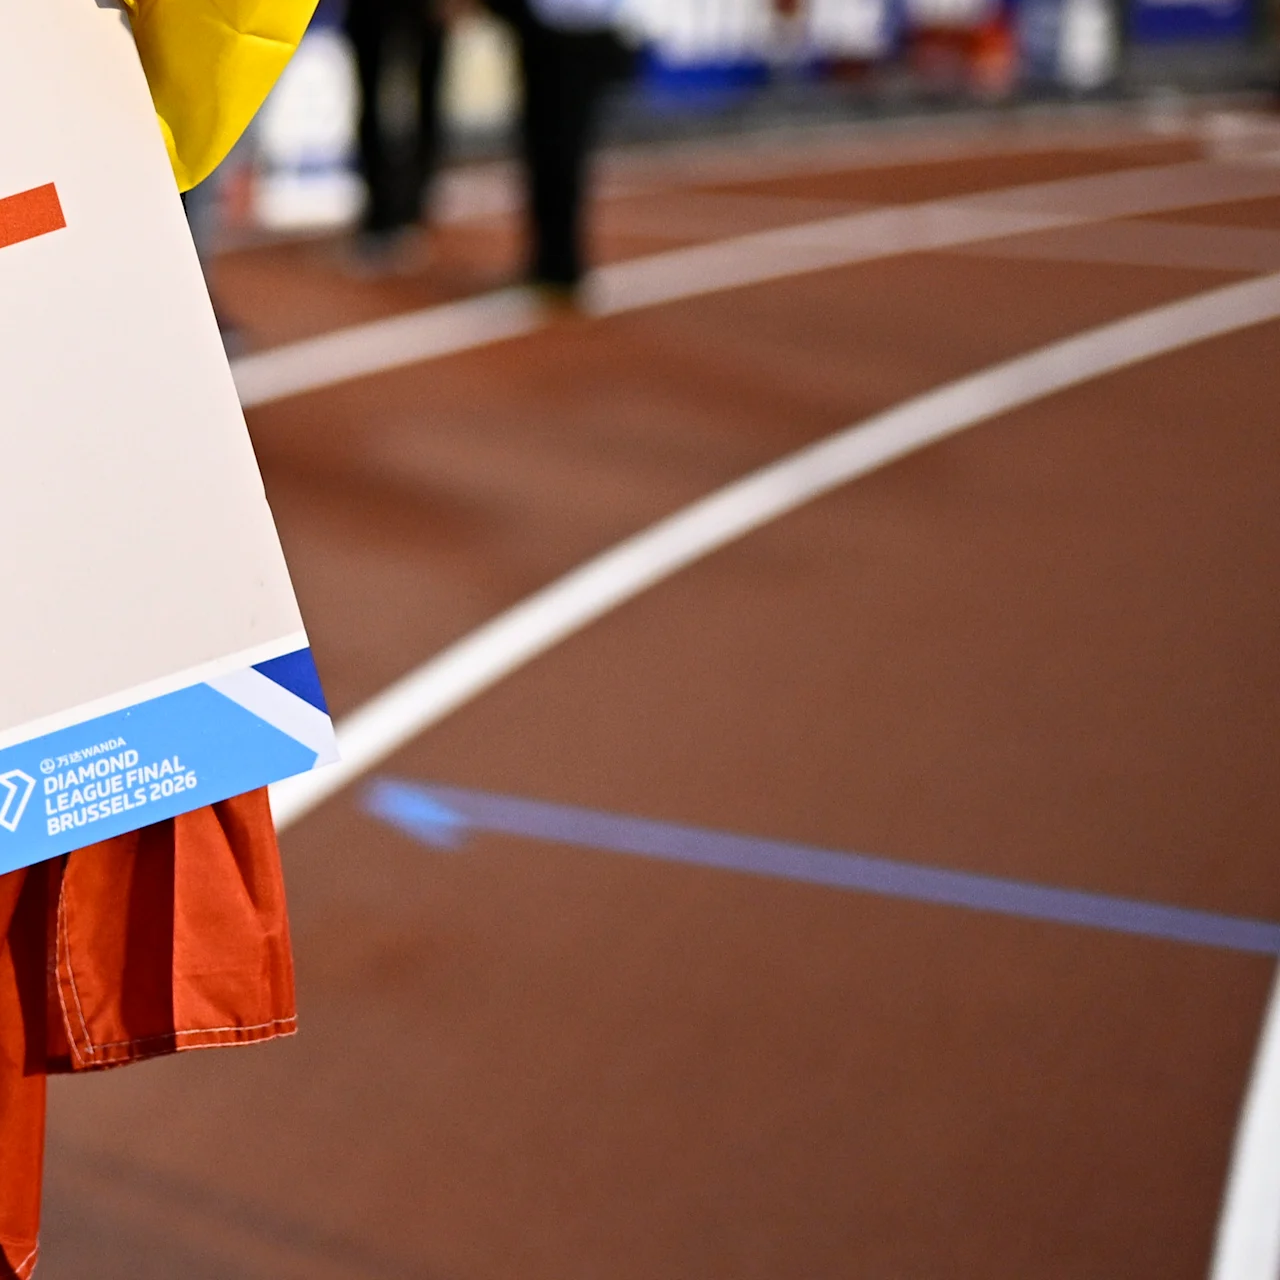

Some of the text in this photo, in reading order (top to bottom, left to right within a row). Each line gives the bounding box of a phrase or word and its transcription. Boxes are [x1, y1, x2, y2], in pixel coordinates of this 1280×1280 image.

[43, 749, 139, 795] DIAMOND
[45, 754, 186, 816] LEAGUE FINAL
[46, 770, 198, 836] BRUSSELS 2026
